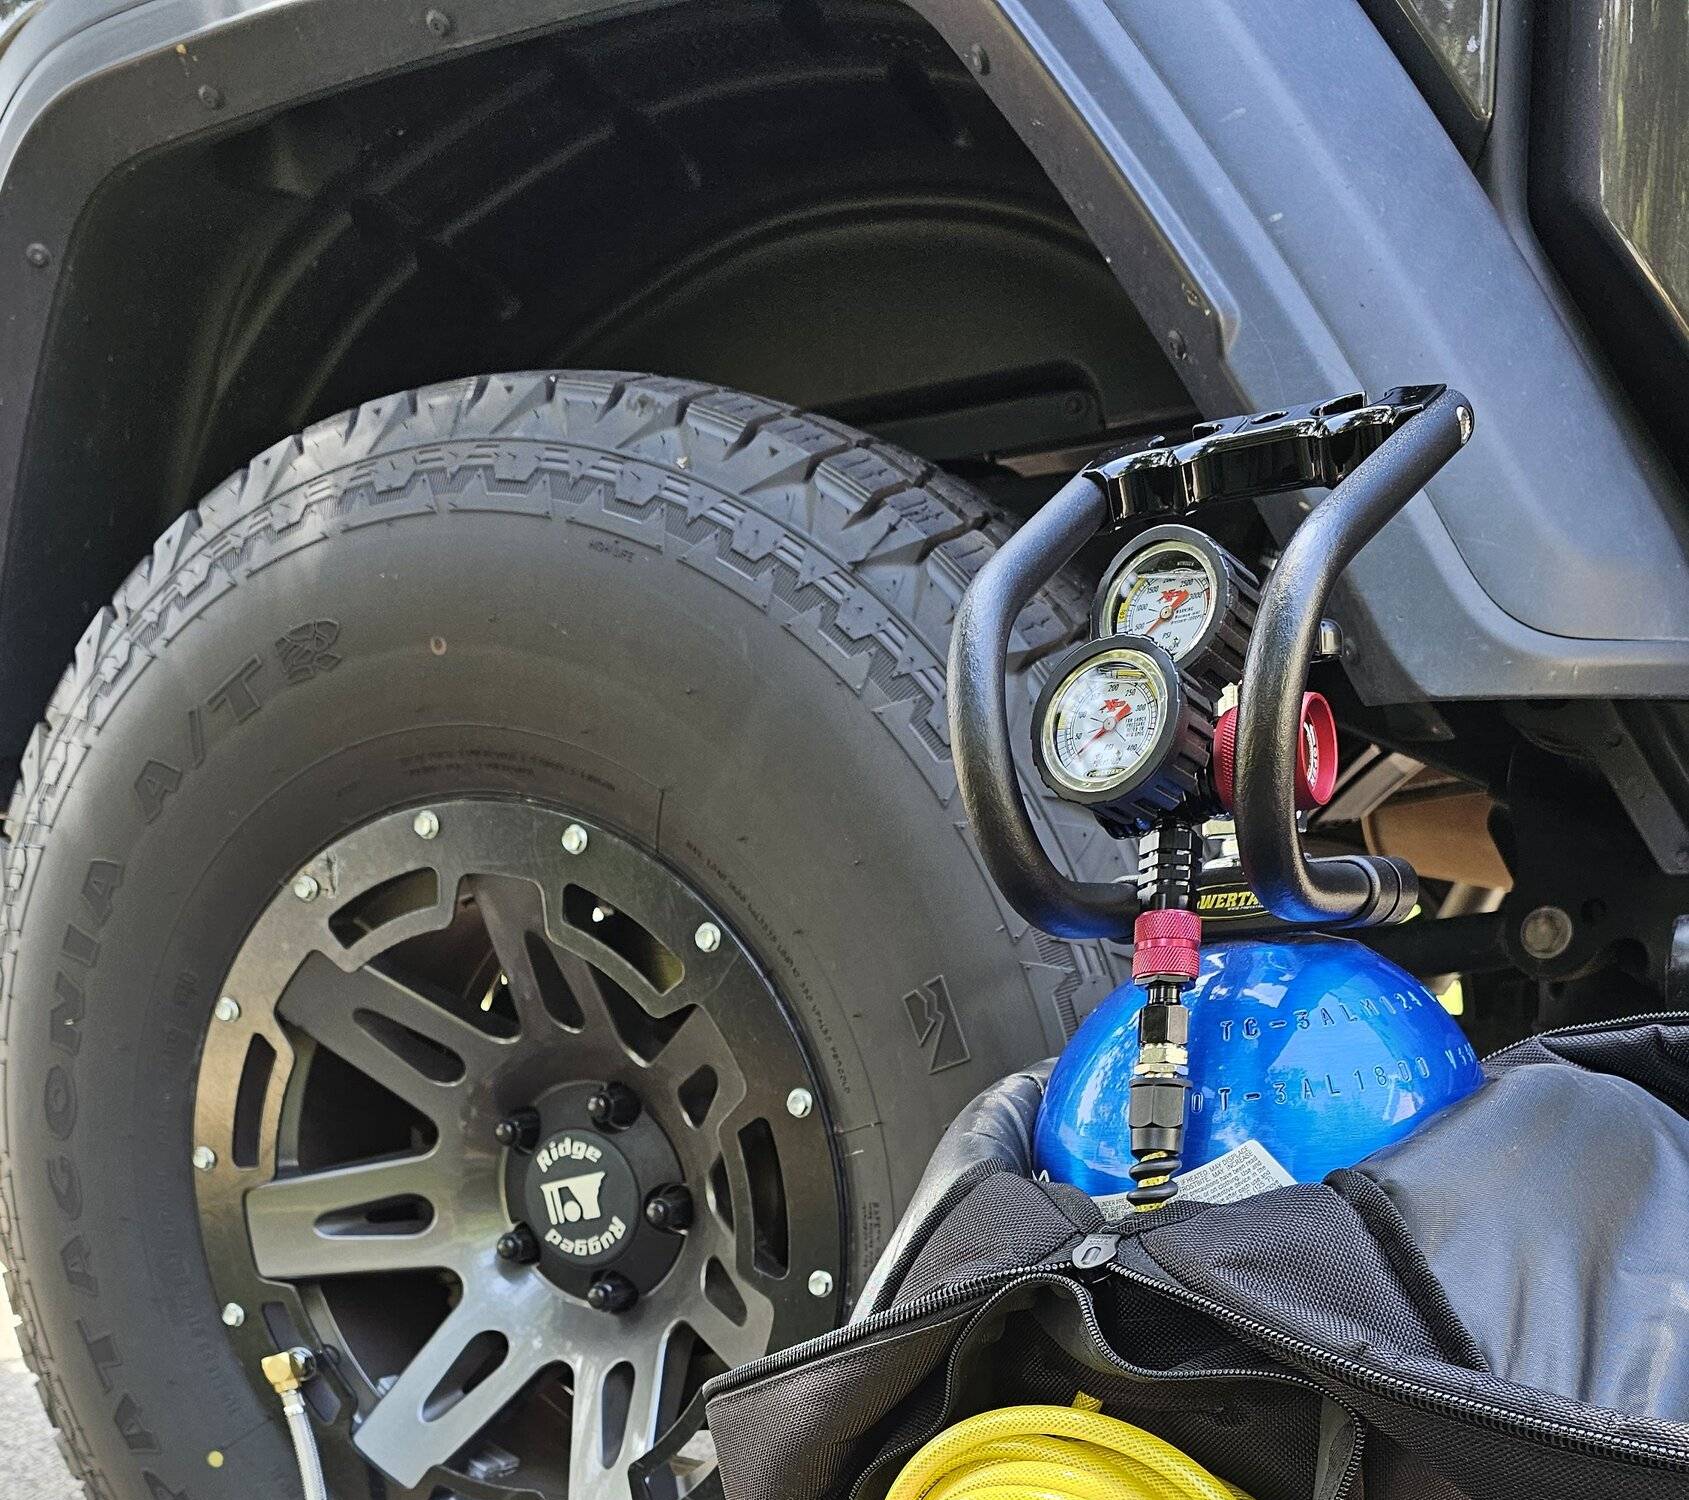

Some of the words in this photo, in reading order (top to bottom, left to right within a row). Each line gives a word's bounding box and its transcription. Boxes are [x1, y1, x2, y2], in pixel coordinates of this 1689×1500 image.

[1146, 585, 1160, 594] 1500
[1134, 622, 1145, 630] 500
[1107, 684, 1120, 692] 200
[1124, 688, 1137, 697] 250
[1197, 891, 1262, 909] WERTA
[1191, 1056, 1431, 1114] OT-3AL1800
[537, 1137, 602, 1172] Ridge
[1208, 1162, 1221, 1172] MAY
[1221, 1146, 1249, 1164] DISPLACE
[1211, 1168, 1224, 1177] MAY
[1225, 1150, 1254, 1169] INCREASE
[1218, 1171, 1232, 1181] have
[1231, 1162, 1245, 1173] been
[1244, 1155, 1258, 1165] read
[1240, 1167, 1251, 1176] Use
[1256, 1164, 1266, 1173] the
[545, 1216, 626, 1256] Rugged
